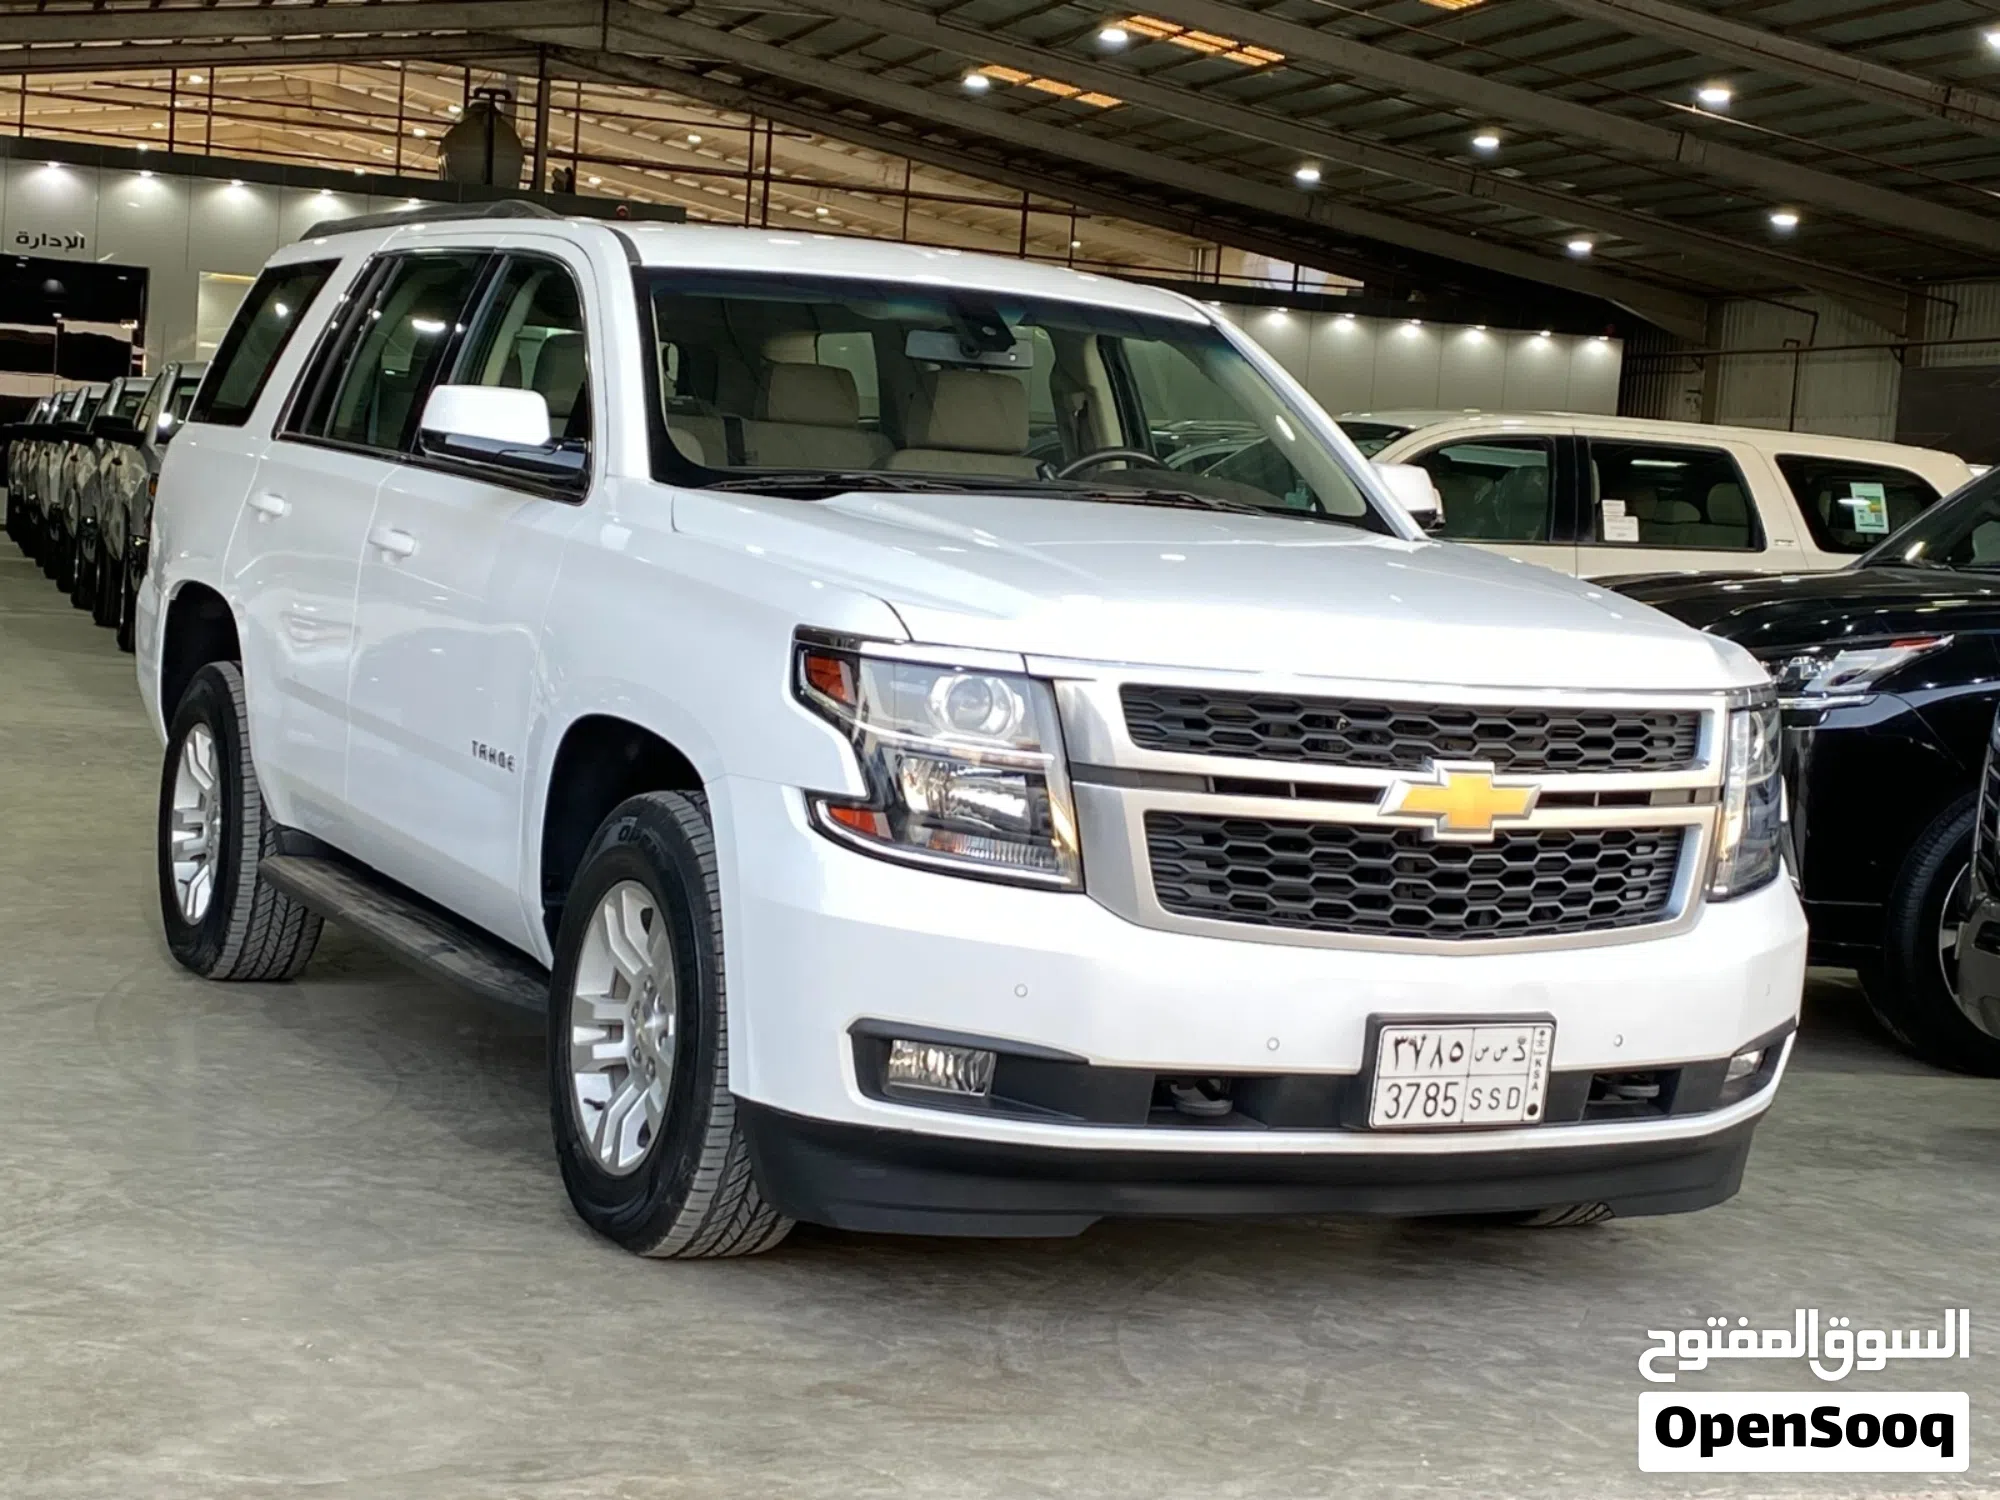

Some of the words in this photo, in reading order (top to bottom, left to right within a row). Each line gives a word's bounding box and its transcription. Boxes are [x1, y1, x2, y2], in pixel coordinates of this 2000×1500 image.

[15, 230, 85, 253] الإدارة
[471, 740, 515, 773] TAHOE
[1531, 1058, 1542, 1091] KSA
[1384, 1081, 1459, 1119] 3785
[1469, 1086, 1521, 1111] SSD
